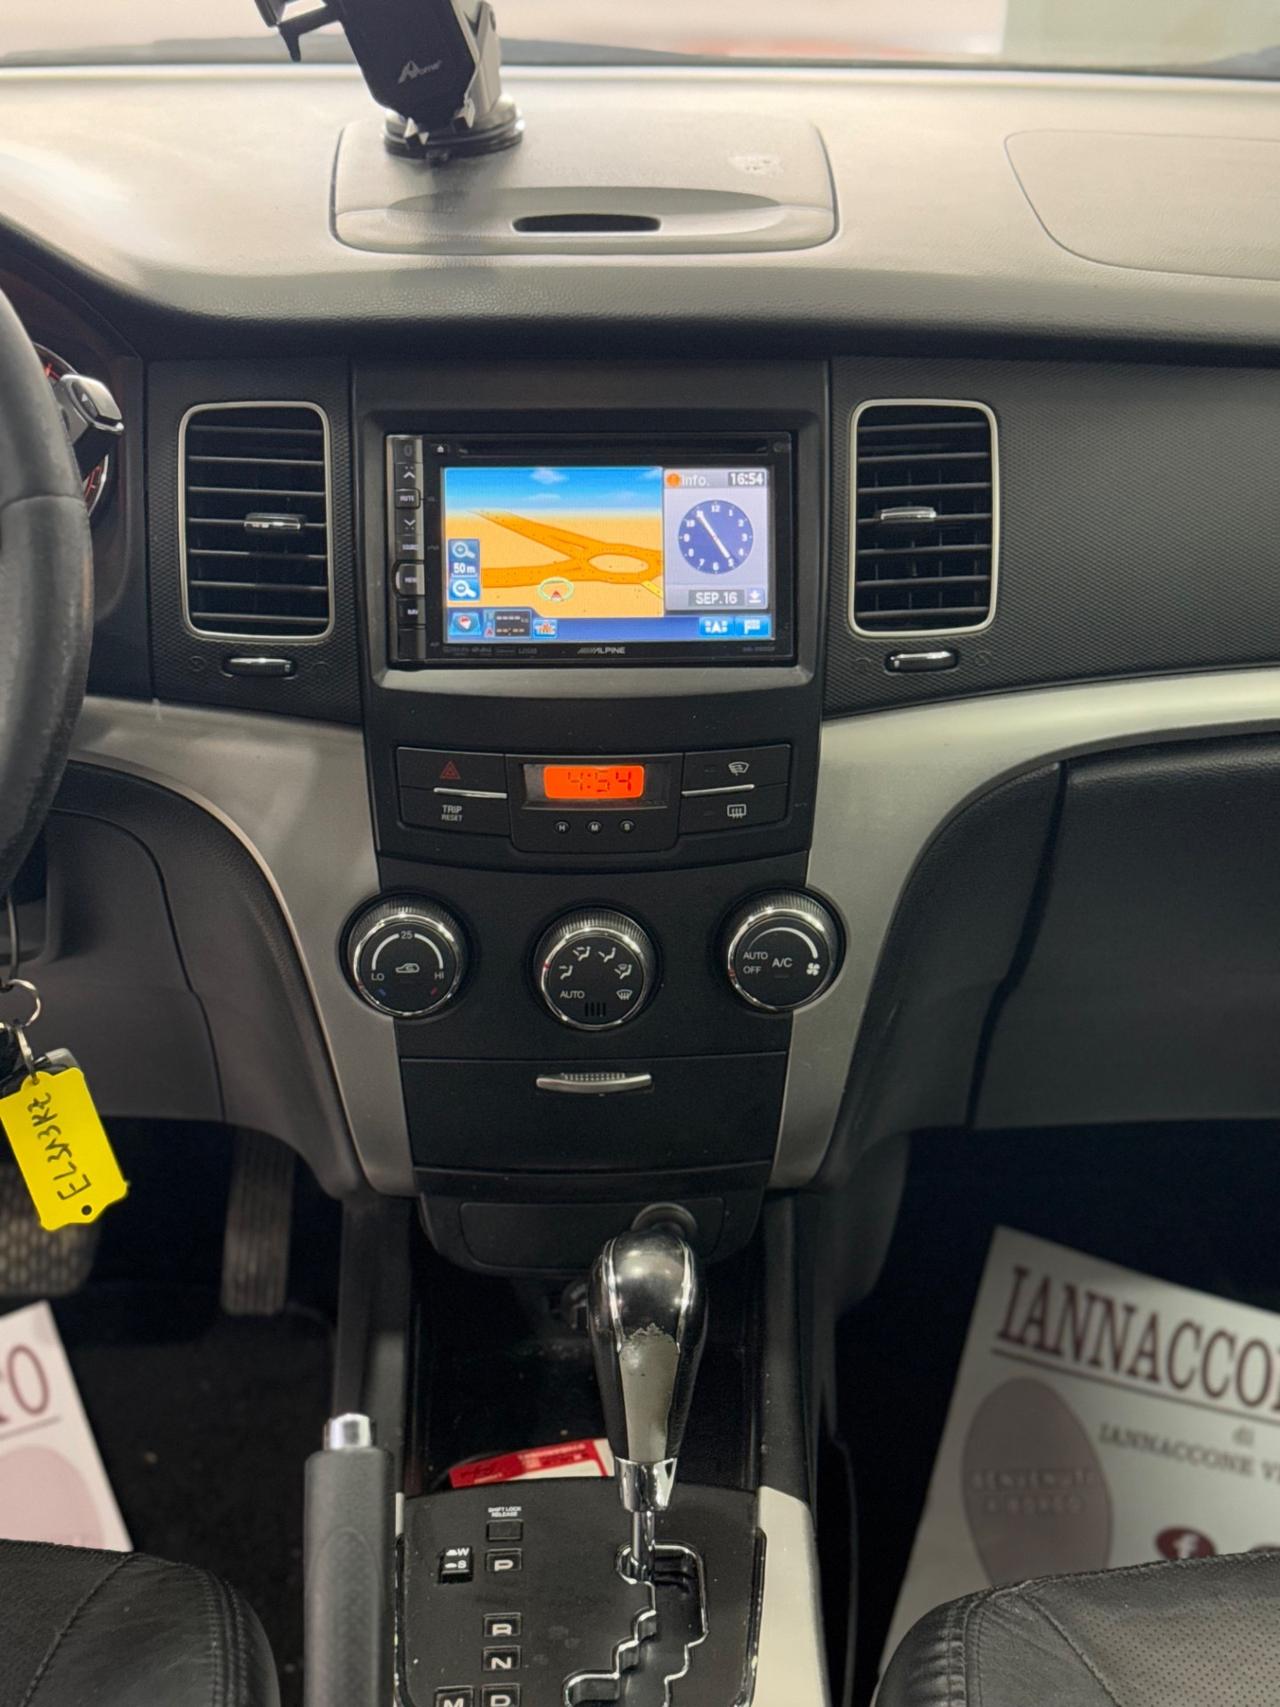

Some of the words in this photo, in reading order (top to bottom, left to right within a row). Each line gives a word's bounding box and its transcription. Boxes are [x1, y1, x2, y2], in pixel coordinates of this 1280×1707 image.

[730, 473, 764, 486] 16:54
[711, 504, 720, 513] 12
[686, 519, 695, 528] 10
[683, 533, 690, 542] 9
[742, 533, 748, 541] 3
[688, 548, 694, 557] 8
[453, 562, 465, 574] 50
[578, 646, 626, 655] ALPINE
[567, 769, 632, 794] 4:54
[442, 804, 463, 814] TRIP
[400, 929, 413, 940] 25
[743, 951, 769, 960] AUTO
[772, 957, 793, 968] A/C
[743, 965, 761, 974] OFF
[371, 972, 385, 981] LO
[434, 971, 445, 980] HI
[560, 990, 585, 999] AUTO
[995, 1265, 1280, 1413] IANNACCO
[457, 1547, 470, 1557] W
[457, 1560, 467, 1569] S
[494, 1559, 514, 1572] P
[492, 1623, 512, 1636] R
[491, 1656, 512, 1670] N
[443, 1697, 465, 1707] M
[490, 1694, 512, 1707] D
